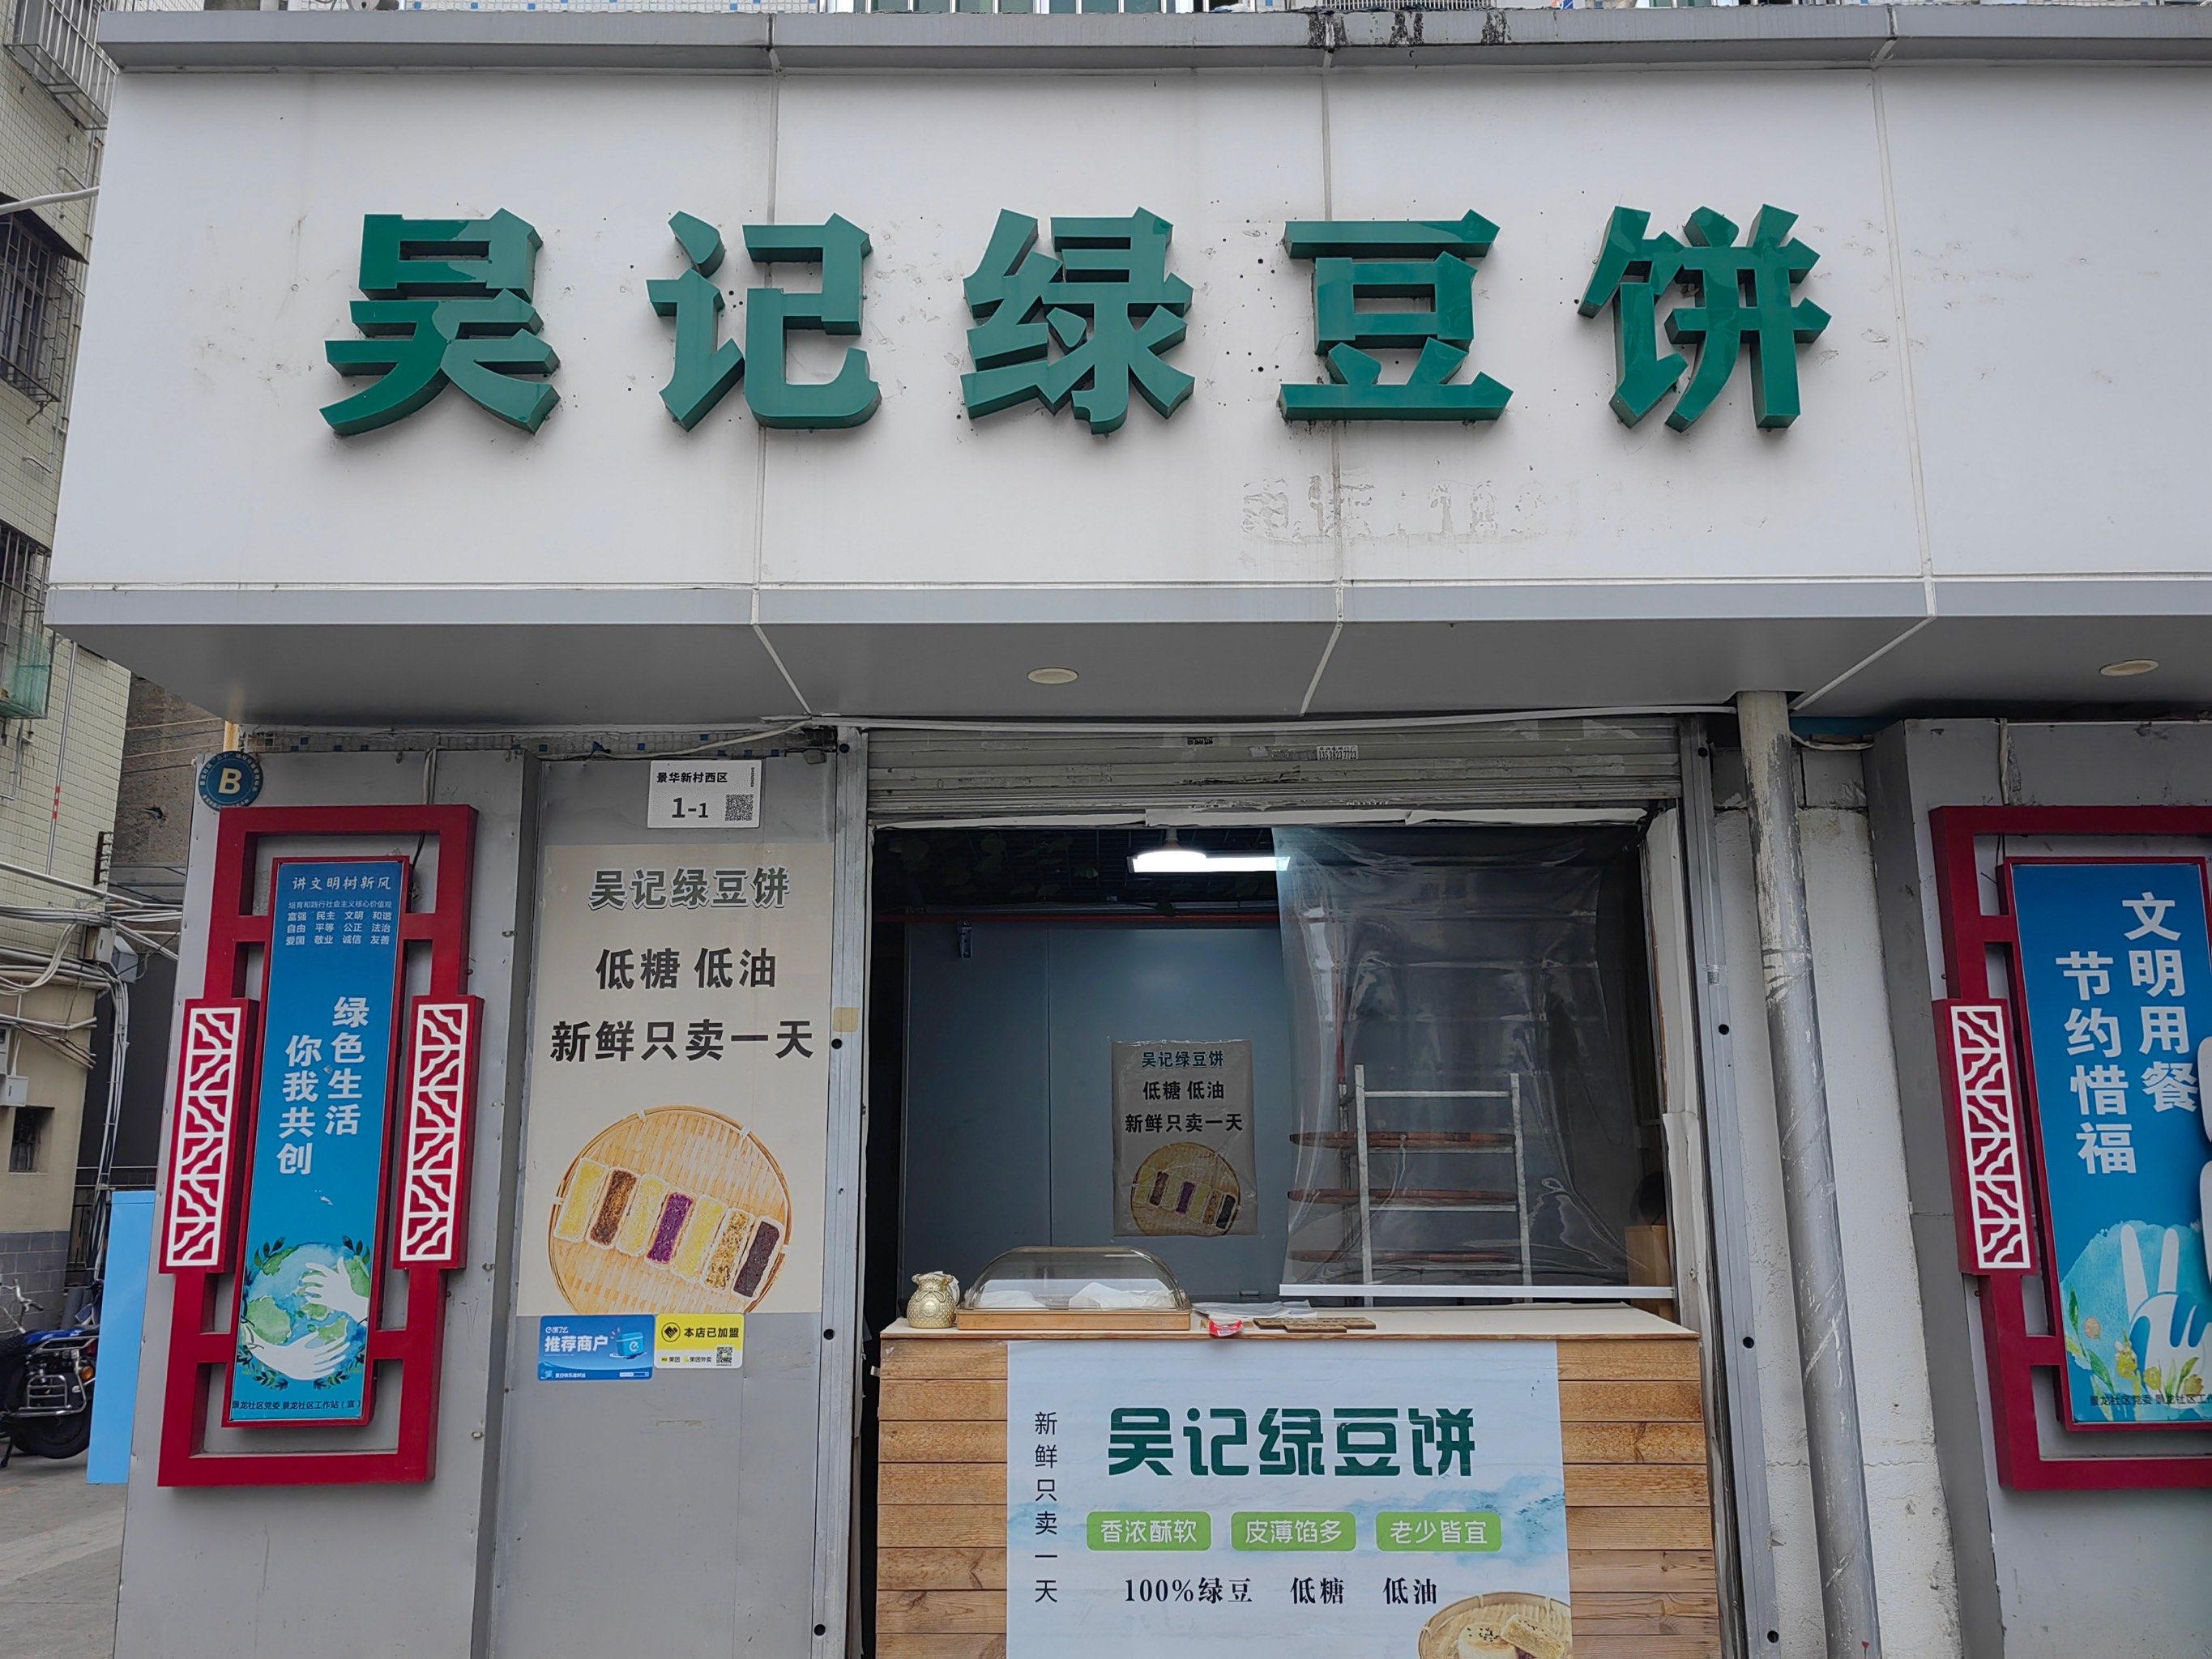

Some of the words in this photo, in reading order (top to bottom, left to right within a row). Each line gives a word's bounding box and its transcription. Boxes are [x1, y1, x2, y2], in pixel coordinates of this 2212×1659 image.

[319, 203, 1832, 436] 吴记绿豆饼
[218, 767, 242, 795] B
[656, 772, 728, 783] 景华新村西区
[672, 797, 709, 818] 1-1
[293, 876, 391, 890] 讲文明树新风
[589, 868, 790, 910] 吴记绿豆饼
[288, 900, 392, 910] 培育和践行社会主义核心价值观
[288, 912, 307, 922] 富强
[316, 911, 335, 921] 民主
[344, 911, 364, 921] 文明
[373, 911, 392, 921] 和谐
[285, 936, 305, 946] 爱国
[314, 935, 334, 945] 敬业
[342, 935, 362, 945] 诚信
[370, 935, 391, 945] 友善
[287, 924, 306, 934] 自由
[315, 923, 335, 933] 平等
[343, 923, 363, 932] 公正
[371, 923, 391, 933] 法治
[596, 948, 681, 991] 低糖
[694, 948, 777, 989] 低油
[2121, 891, 2199, 1114] 文明用餐
[550, 1019, 815, 1063] 新鲜只卖一天
[324, 996, 370, 1136] 绿色生活
[1142, 1051, 1223, 1068] 吴记绿豆饼
[2056, 950, 2137, 1175] 节约惜福
[276, 1034, 323, 1176] 你我共创
[1142, 1081, 1181, 1101] 低糖
[1187, 1081, 1224, 1100] 低油
[1125, 1113, 1244, 1133] 新鲜只卖一天
[544, 1335, 609, 1353] 推荐商户
[684, 1327, 740, 1338] 本店已加盟
[1108, 1407, 1476, 1478] 吴记绿豆饼
[1034, 1412, 1058, 1604] 新鲜只卖一天
[1100, 1518, 1198, 1546] 香浓酥软
[1245, 1518, 1343, 1546] 皮薄馅多
[1389, 1518, 1488, 1546] 老少皆宜
[1124, 1576, 1253, 1605] 100%绿豆
[1290, 1576, 1345, 1606] 低糖
[1382, 1576, 1437, 1606] 低油
